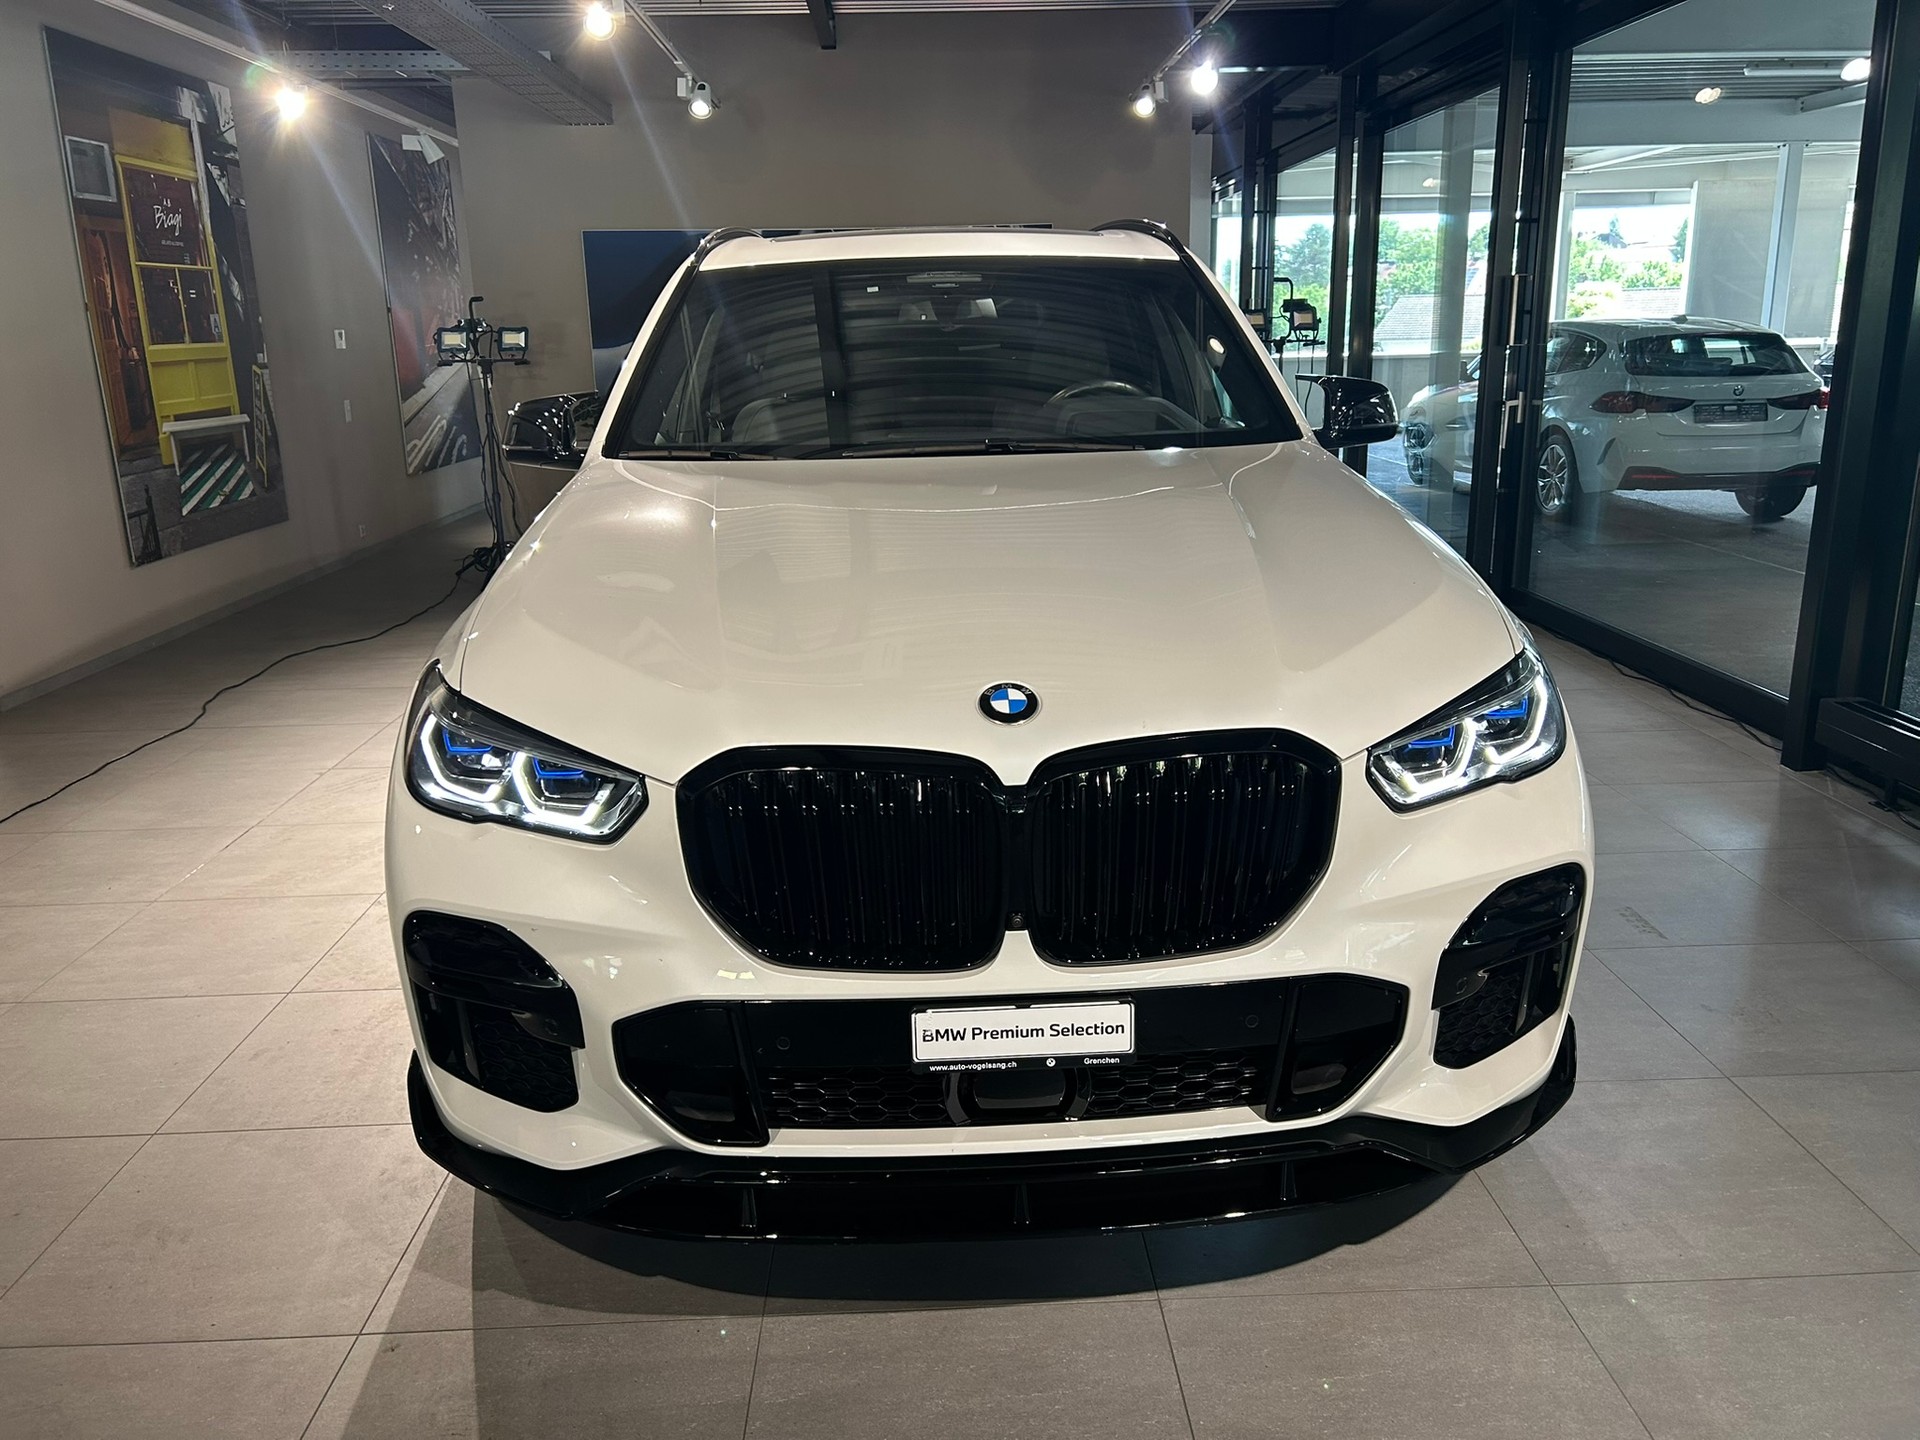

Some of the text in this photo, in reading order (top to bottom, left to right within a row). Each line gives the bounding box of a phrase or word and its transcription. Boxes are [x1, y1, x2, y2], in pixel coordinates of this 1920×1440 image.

[153, 205, 182, 236] Biagi
[984, 683, 1032, 696] BMW
[922, 1022, 1125, 1042] BMW Premium Selection
[929, 1061, 1017, 1072] www.auto-vogelsang.ch
[1083, 1057, 1120, 1065] Grenchen
